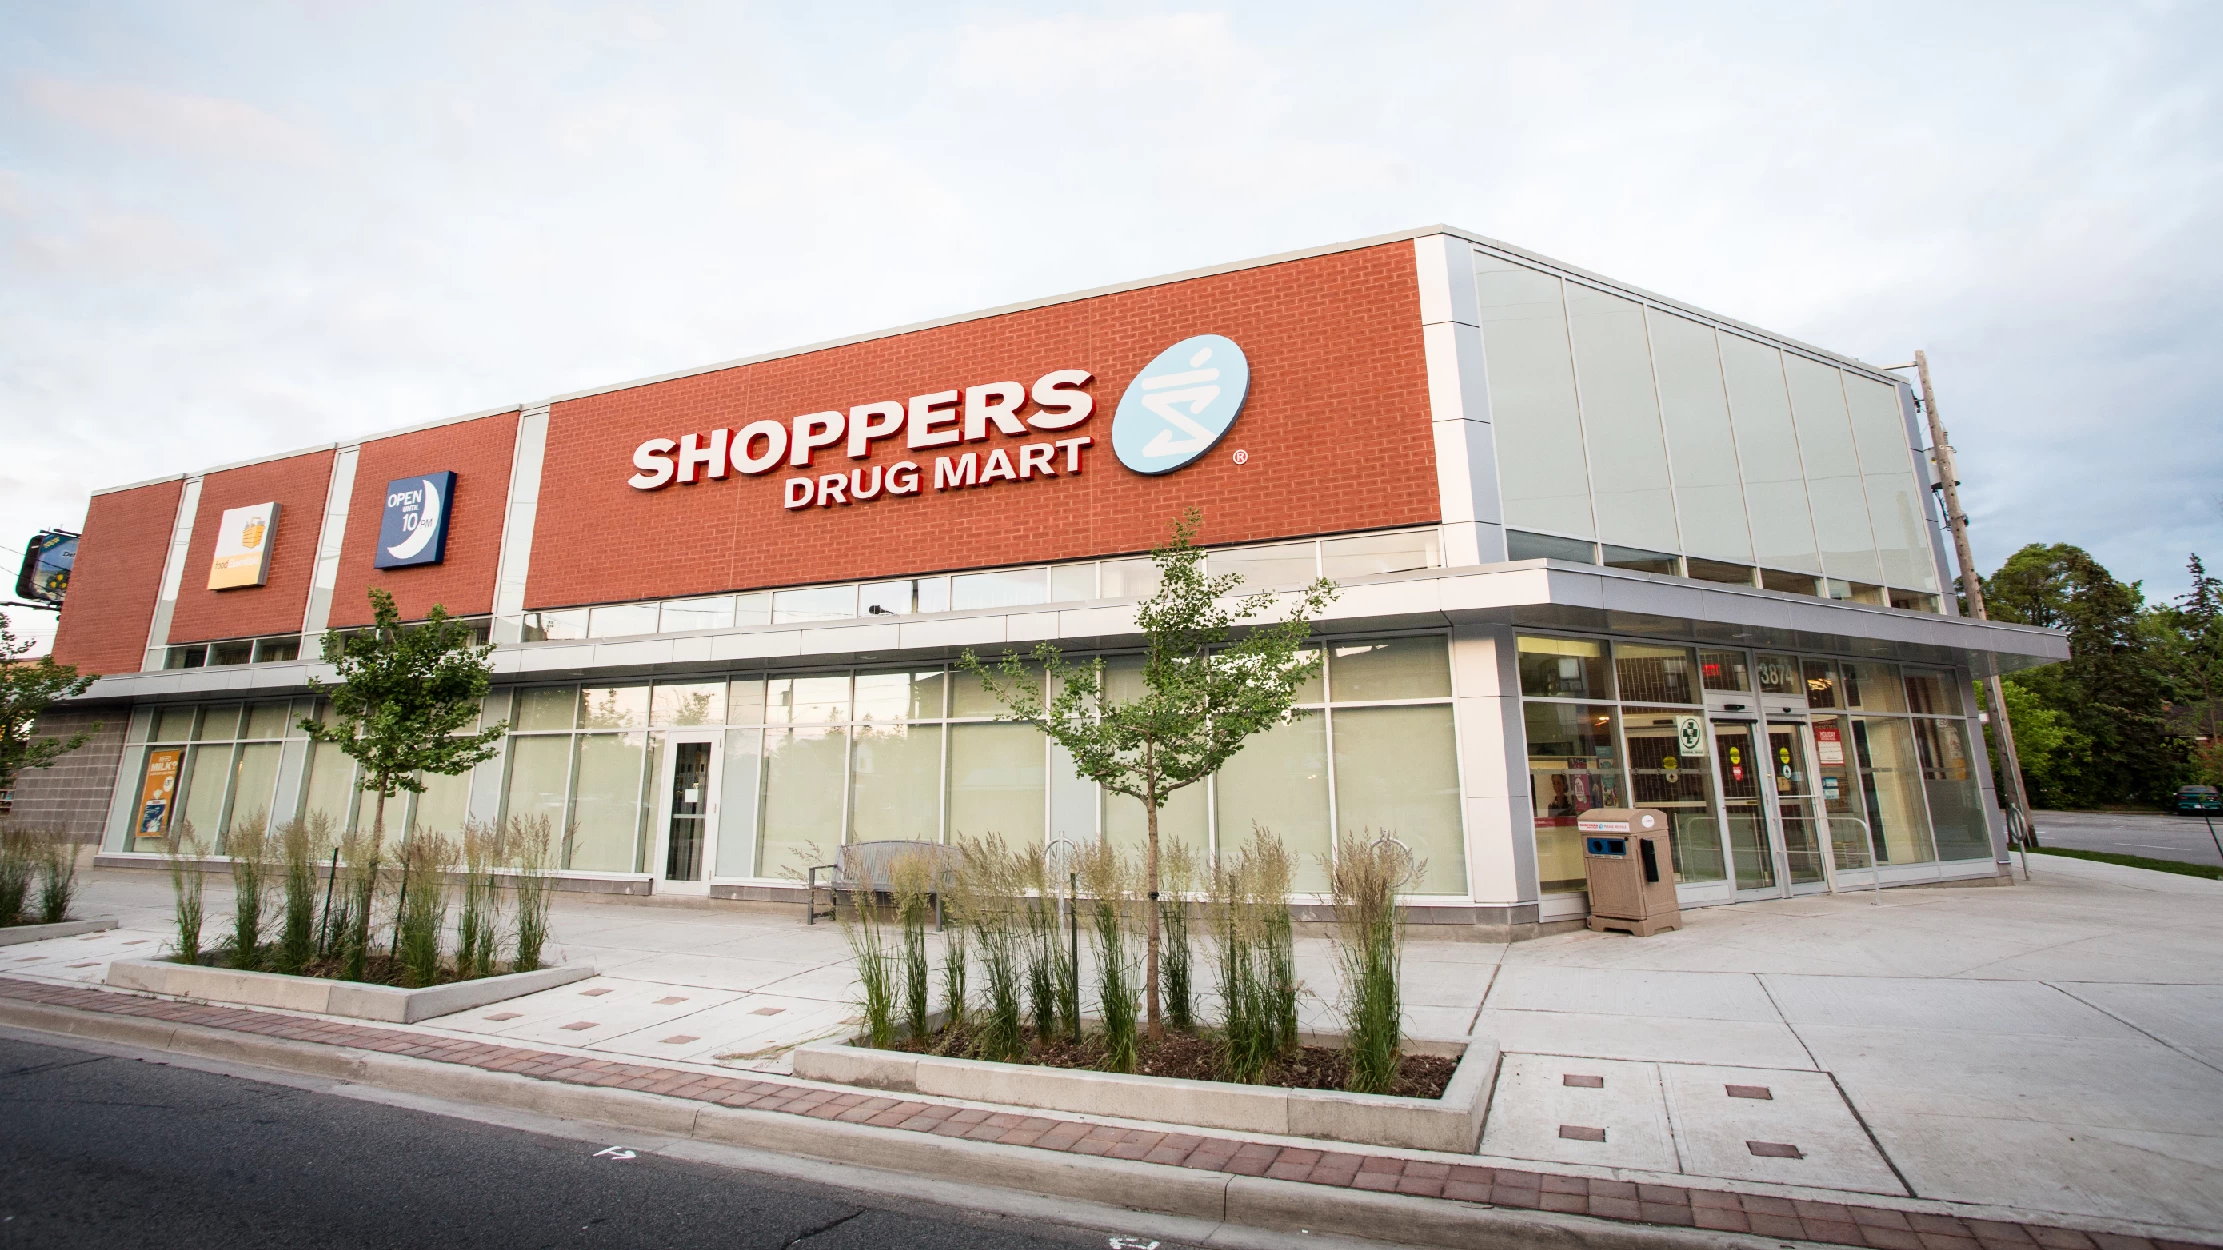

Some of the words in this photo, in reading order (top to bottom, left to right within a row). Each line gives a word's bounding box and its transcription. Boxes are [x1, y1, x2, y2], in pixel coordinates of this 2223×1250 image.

[628, 369, 1095, 490] SHOPPERS
[785, 458, 920, 509] DRUG
[933, 437, 1092, 490] MART
[387, 490, 422, 508] OPEN
[402, 512, 418, 532] 10
[420, 518, 433, 528] PM
[1759, 663, 1794, 685] 3874
